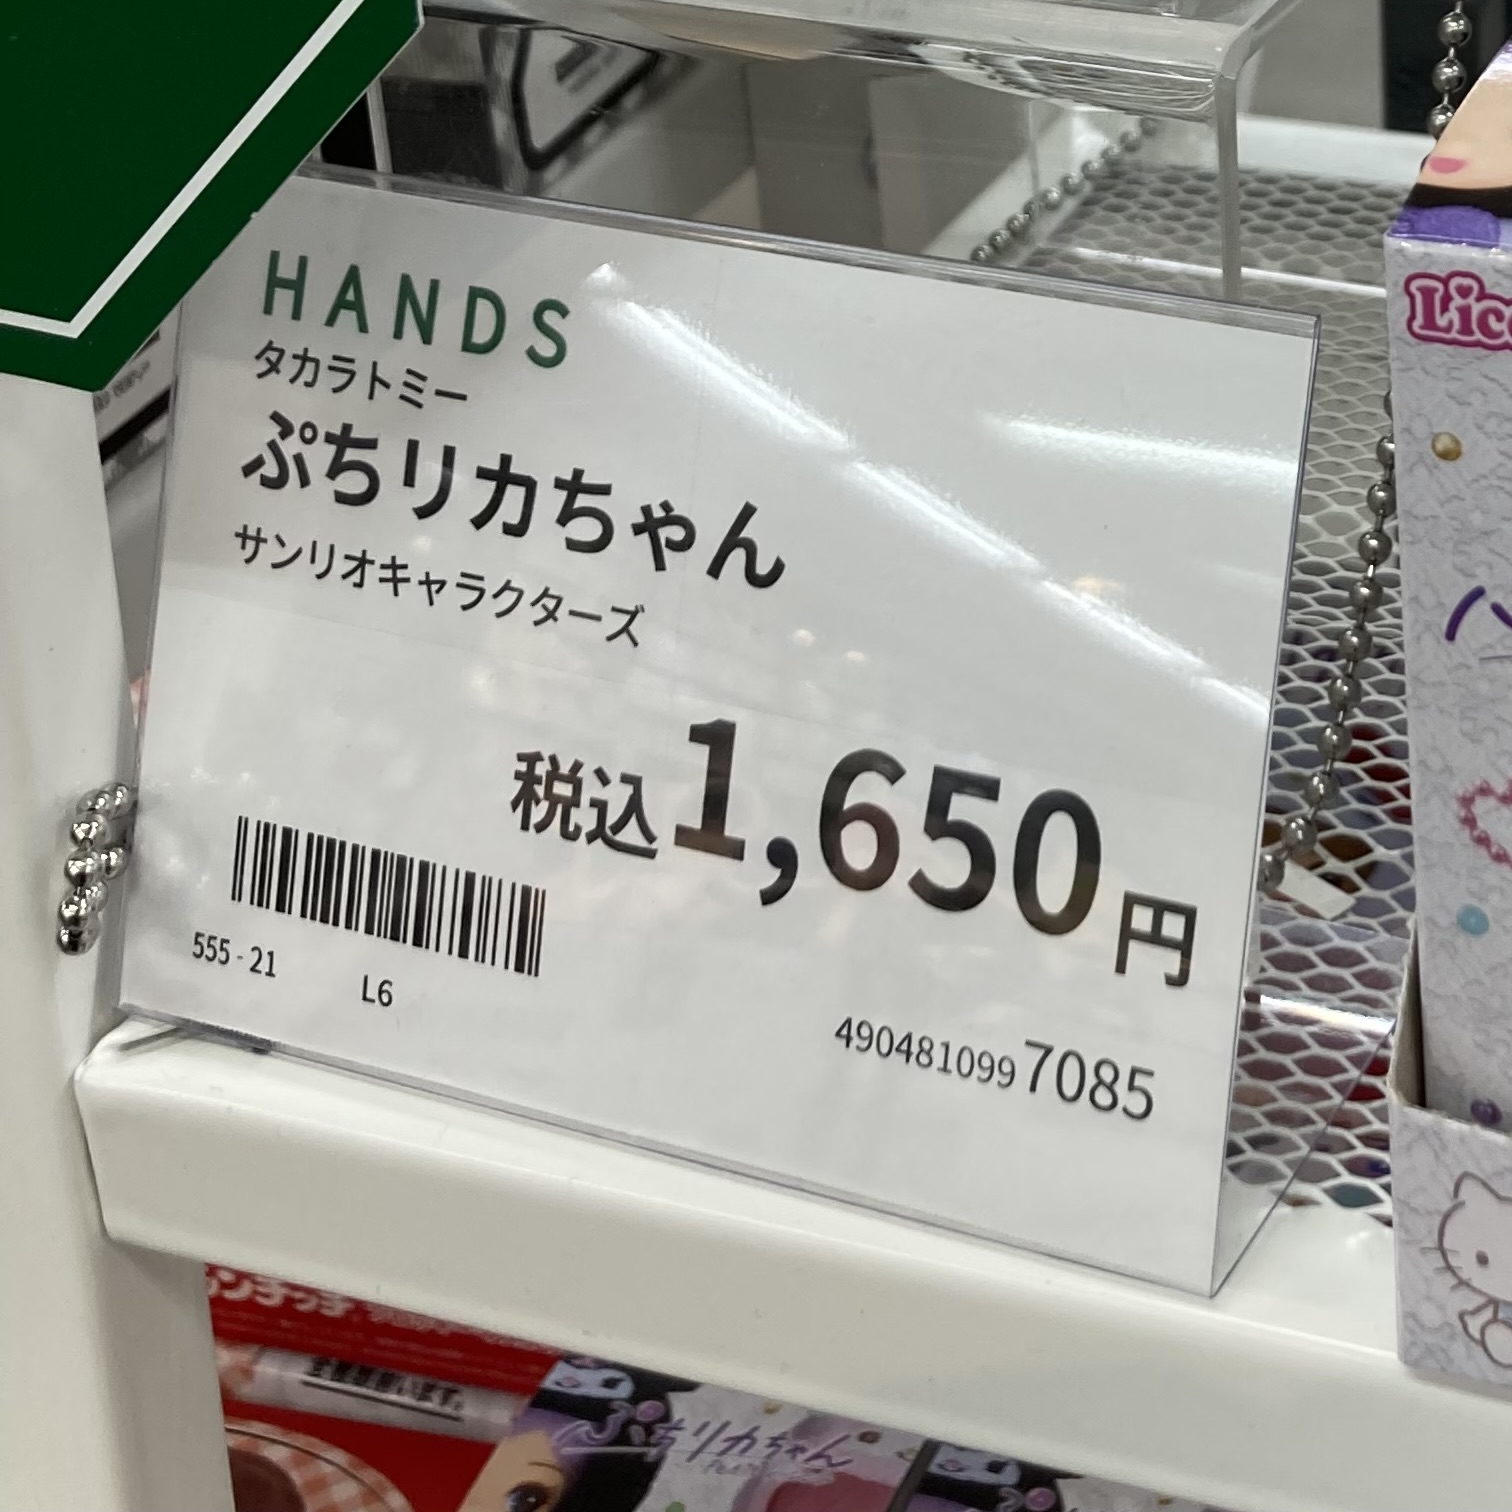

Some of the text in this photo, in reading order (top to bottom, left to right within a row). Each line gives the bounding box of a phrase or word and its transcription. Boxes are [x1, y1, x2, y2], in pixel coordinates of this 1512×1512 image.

[263, 249, 571, 369] HANDS
[255, 339, 468, 409] タカラトミー
[241, 410, 786, 589] ぷちリカちゃん
[235, 524, 646, 648] サンリオキャラクターズ
[361, 975, 394, 1007] L6
